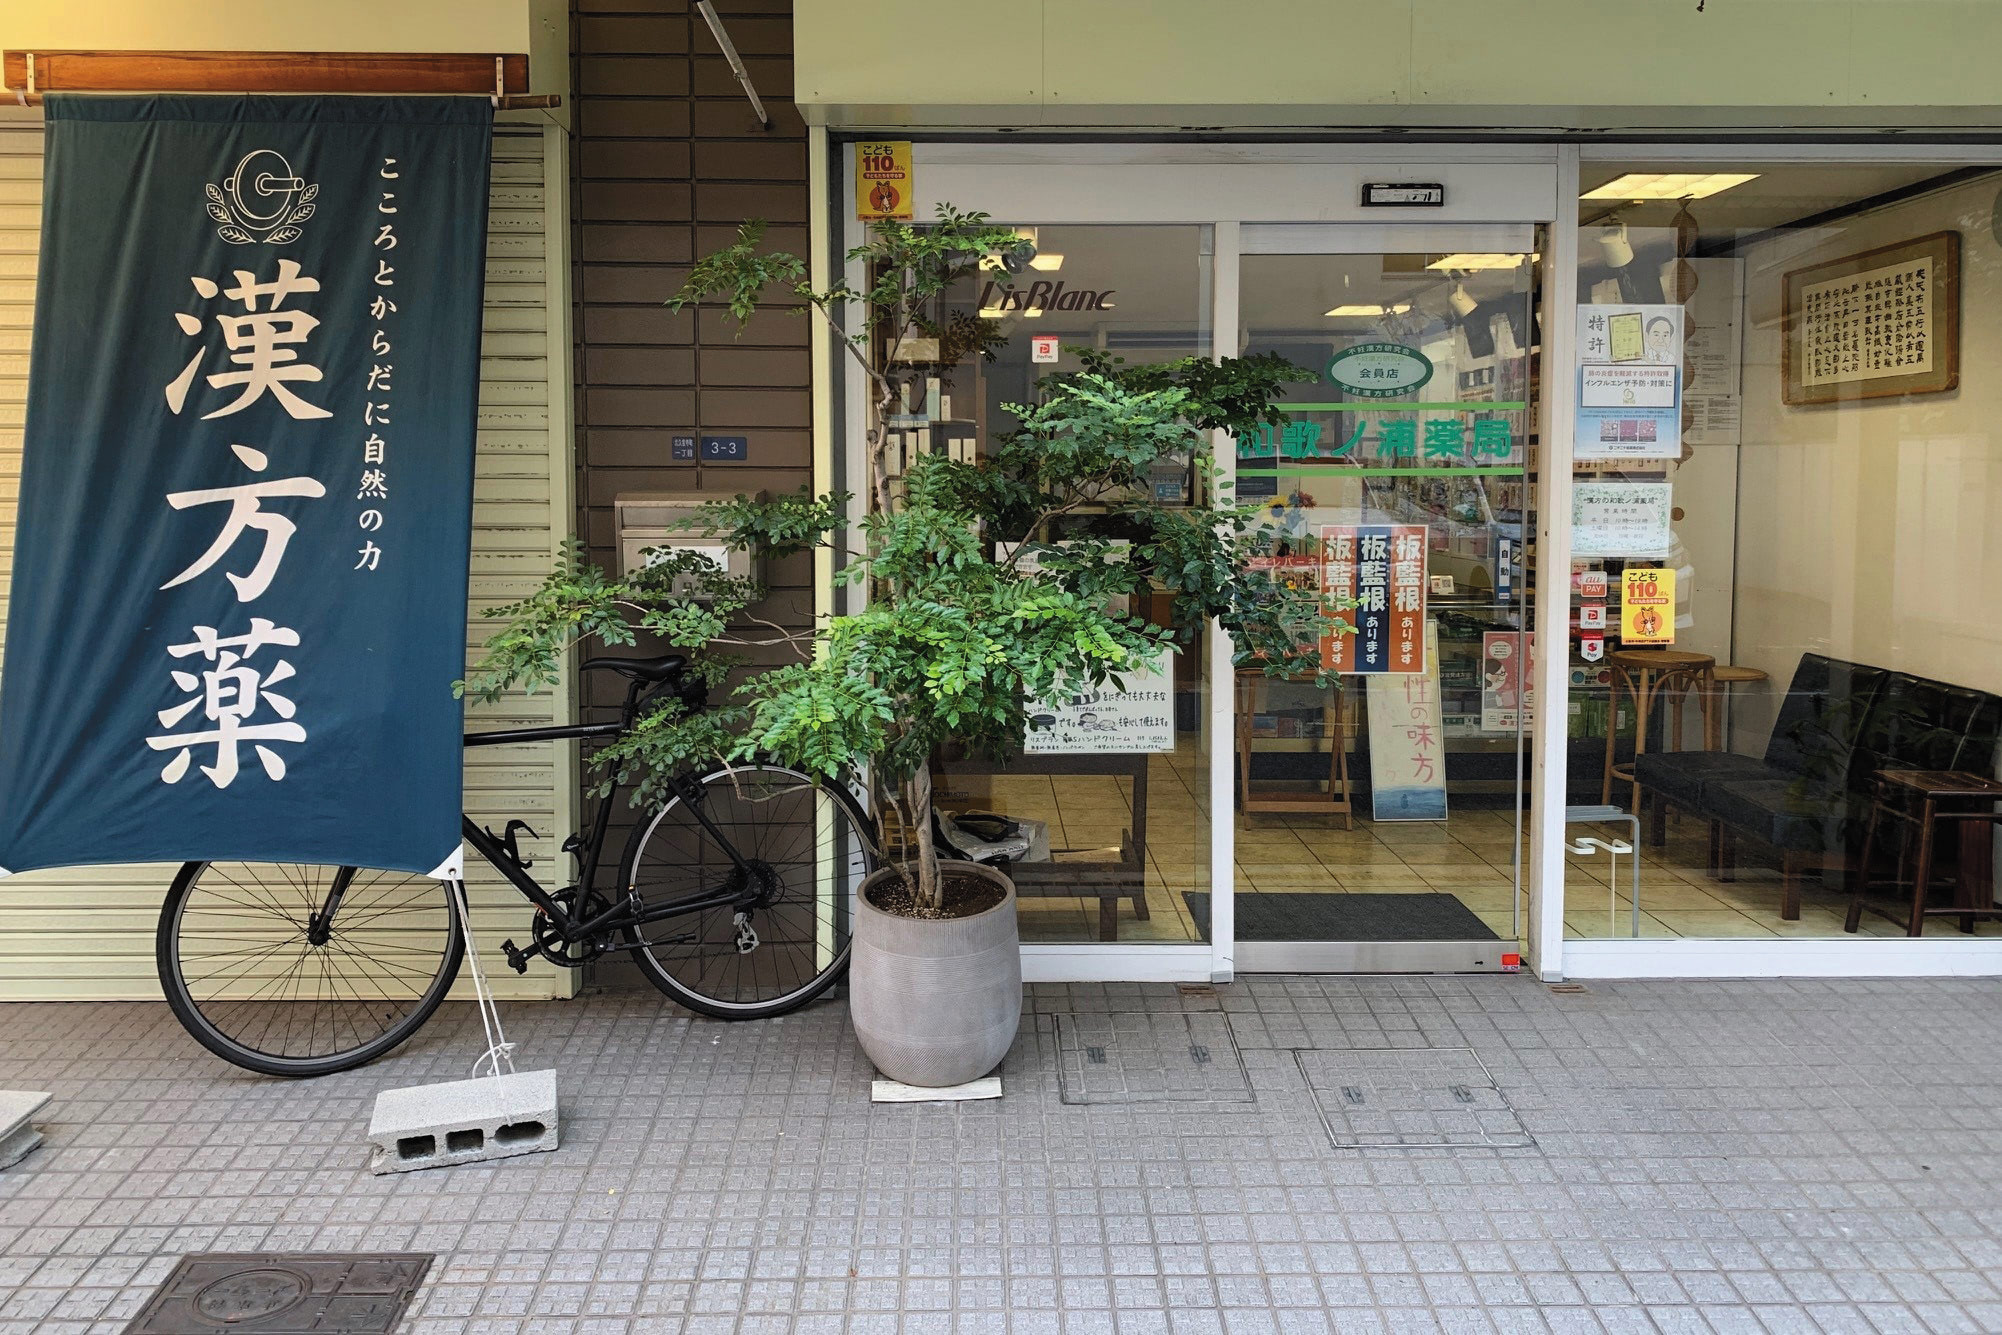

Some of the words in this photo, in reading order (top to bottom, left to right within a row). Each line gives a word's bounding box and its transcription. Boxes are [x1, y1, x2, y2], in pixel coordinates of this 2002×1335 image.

[862, 144, 894, 156] こども
[977, 280, 1117, 311] LisBlanc
[1588, 315, 1605, 354] 特許
[353, 156, 399, 571] こころとからだに自然の力
[1359, 368, 1399, 379] 会員店
[711, 441, 737, 454] 3-3
[145, 258, 334, 789] 漢方薬
[1325, 534, 1353, 612] 板藍根
[1360, 534, 1387, 612] 板藍根
[1394, 534, 1422, 613] 板藍根
[1586, 585, 1602, 593] PAY
[1628, 571, 1658, 582] こども
[1366, 615, 1379, 665] あります
[1401, 615, 1414, 665] あります
